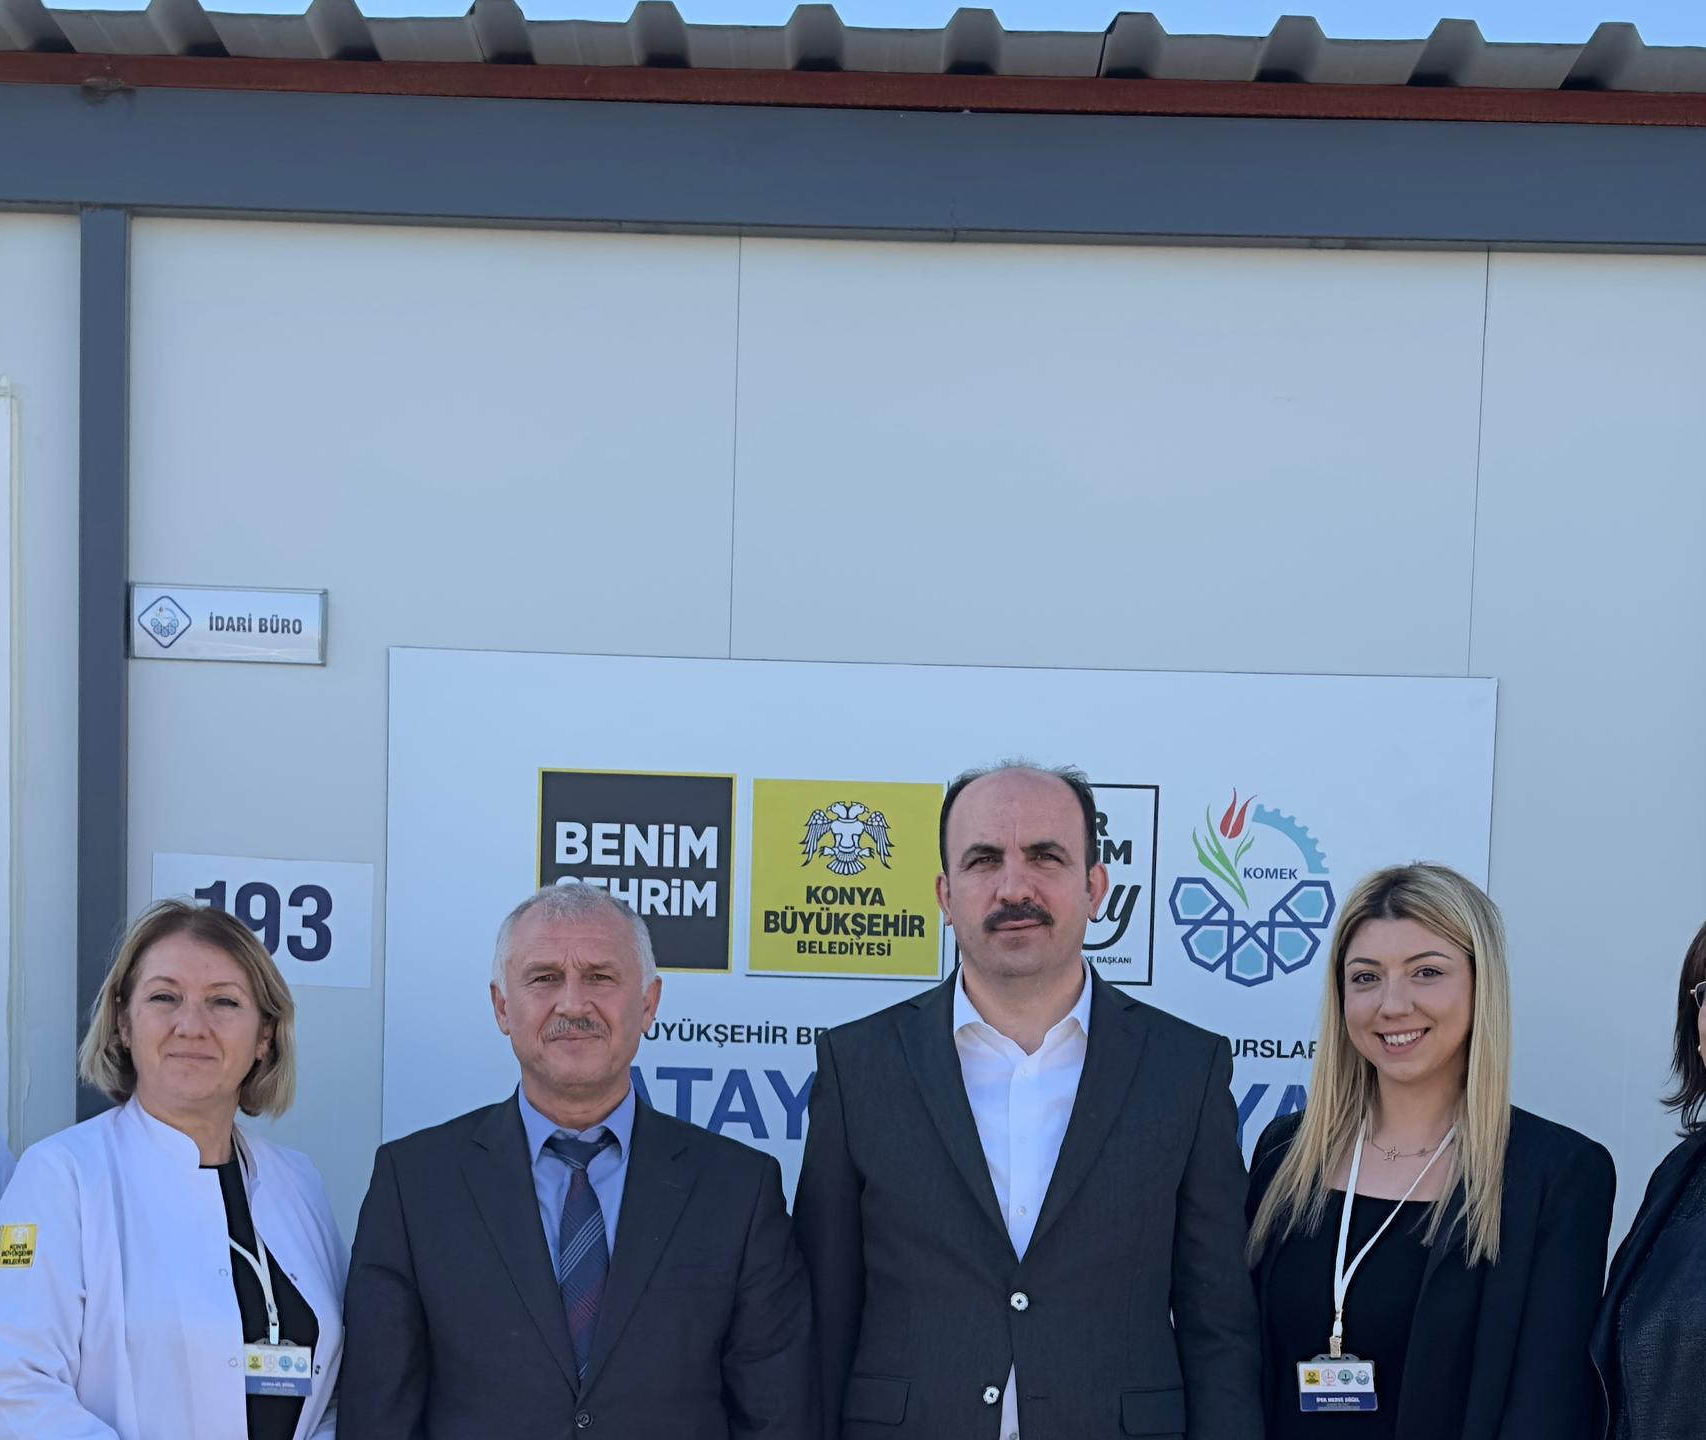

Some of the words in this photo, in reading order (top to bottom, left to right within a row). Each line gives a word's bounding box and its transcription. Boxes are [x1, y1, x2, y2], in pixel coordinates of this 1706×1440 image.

[209, 612, 252, 633] İDARİ
[258, 615, 303, 635] BÜRO
[1243, 867, 1298, 880] KOMEK
[555, 877, 718, 917] HRİM
[805, 885, 886, 906] KONYA
[763, 906, 925, 940] BÜYÜKŞEHİR
[796, 938, 892, 957] BELEDİYESİ
[1096, 956, 1132, 966] BAŞKANI
[644, 1018, 788, 1048] ÜYÜKŞEHİR
